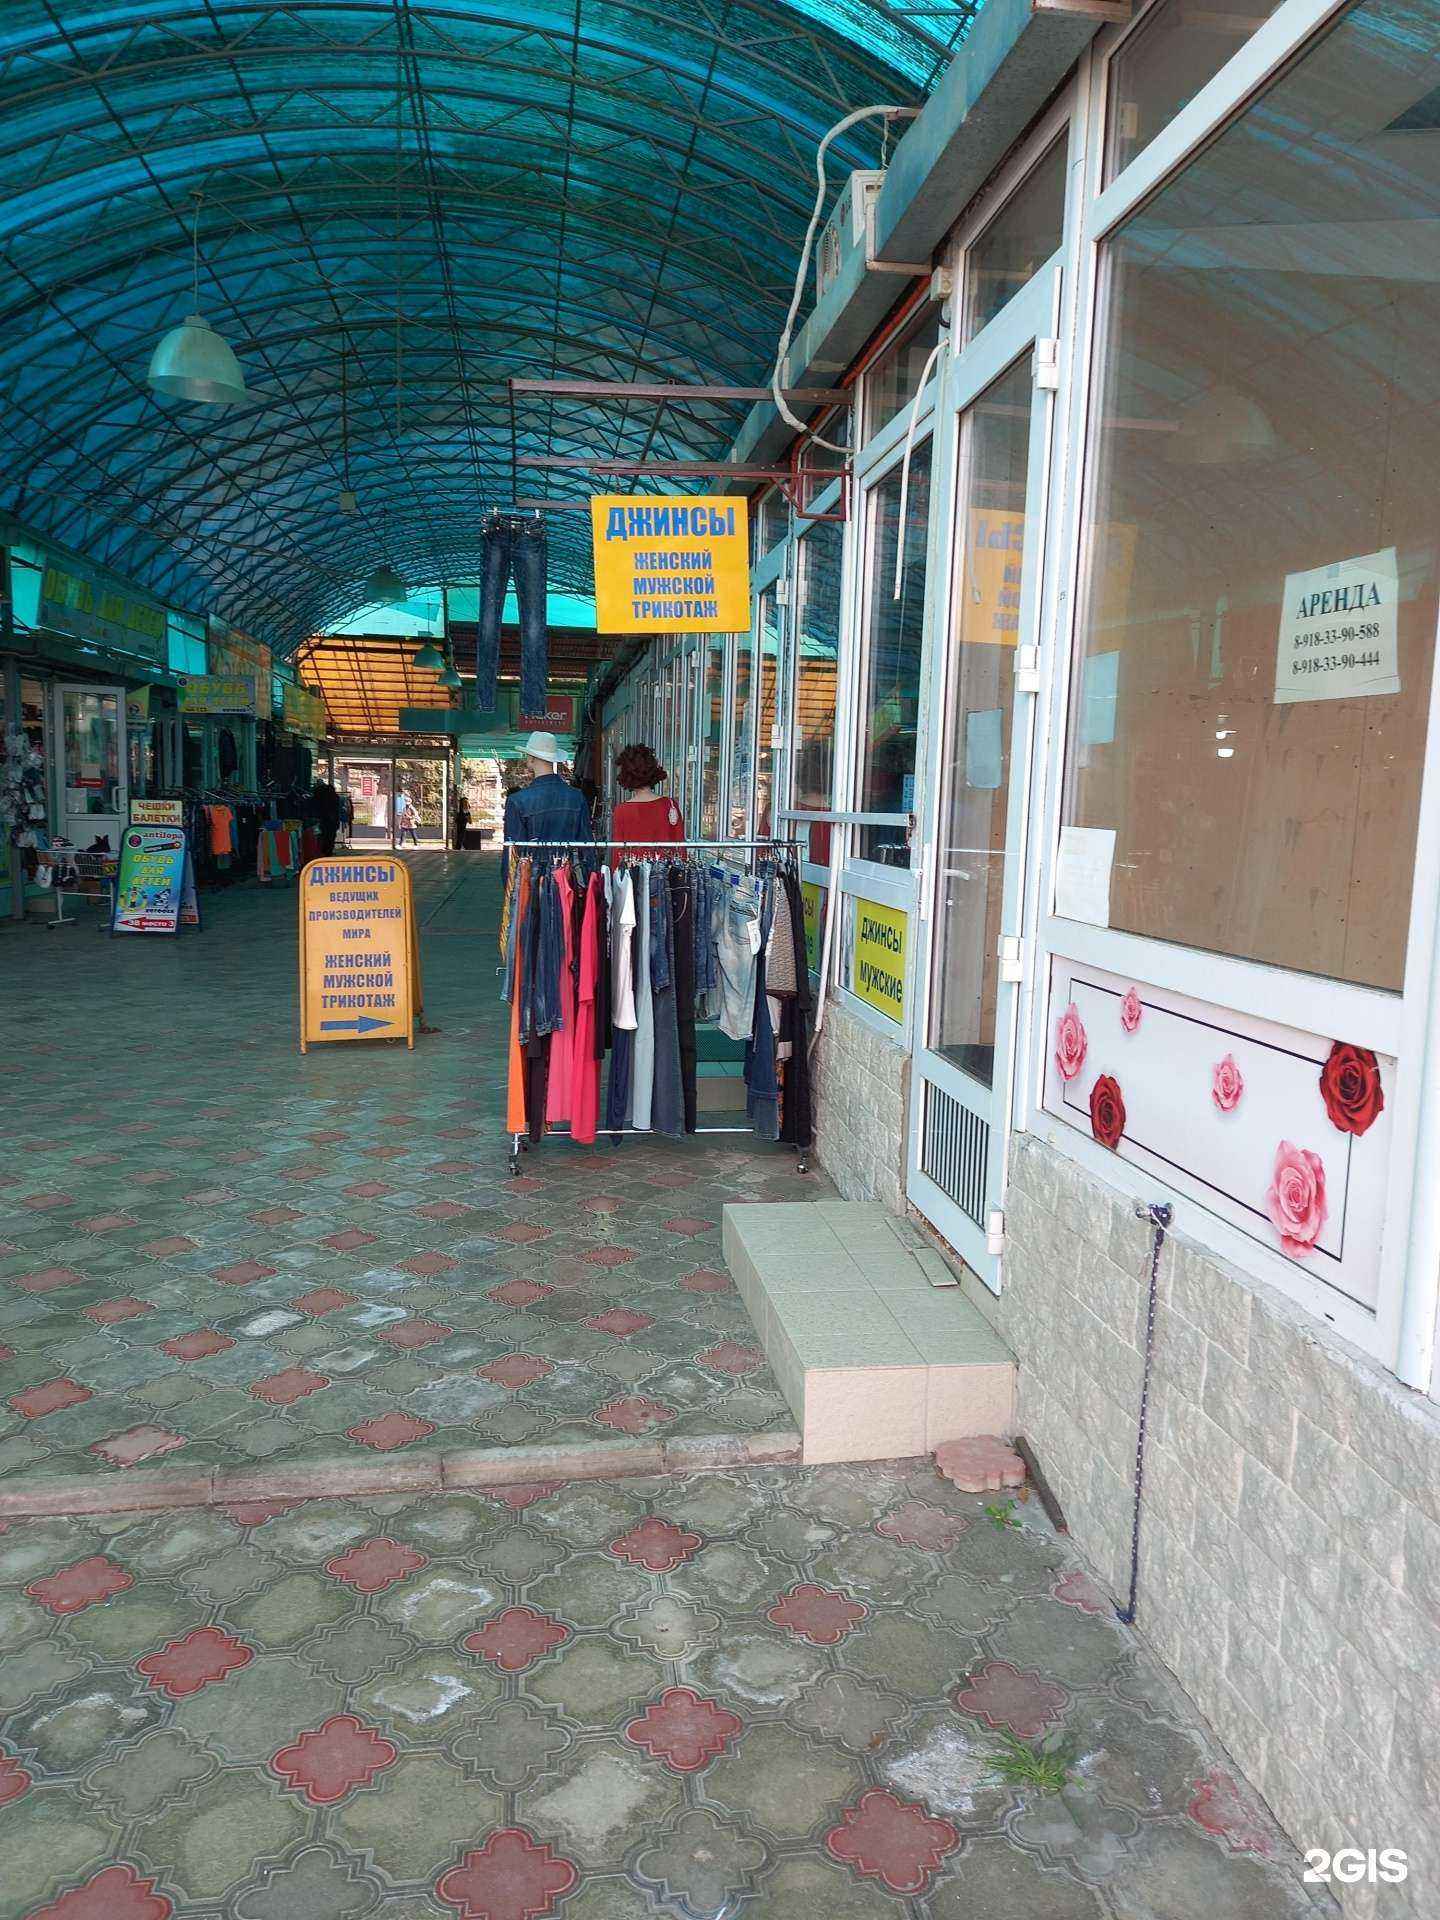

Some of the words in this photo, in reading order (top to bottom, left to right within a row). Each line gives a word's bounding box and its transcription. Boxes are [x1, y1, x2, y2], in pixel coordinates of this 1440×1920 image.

[606, 507, 735, 541] ДЖИНСЫ
[634, 549, 712, 570] ЖЕНСКИЙ
[633, 573, 714, 595] МУЖСКОЙ
[632, 600, 718, 618] ТРИКОТАЖ
[1296, 581, 1382, 619] АРЕНДА
[1293, 622, 1380, 650] 8-918-33-90-588
[1292, 651, 1380, 675] 8-918-33-90-444
[138, 802, 176, 811] ЧЕШКИ
[132, 814, 180, 823] БАЛЕТКИ
[310, 865, 395, 886] ДЖИНСЫ
[308, 908, 402, 922] ПРОИЗВОДИТЕЛЕЙ
[342, 929, 371, 939] МИРА
[325, 951, 392, 968] ЖЕНСКИЙ
[323, 971, 393, 988] МУЖСКОЙ
[321, 993, 395, 1008] ТРИКОТАЖ
